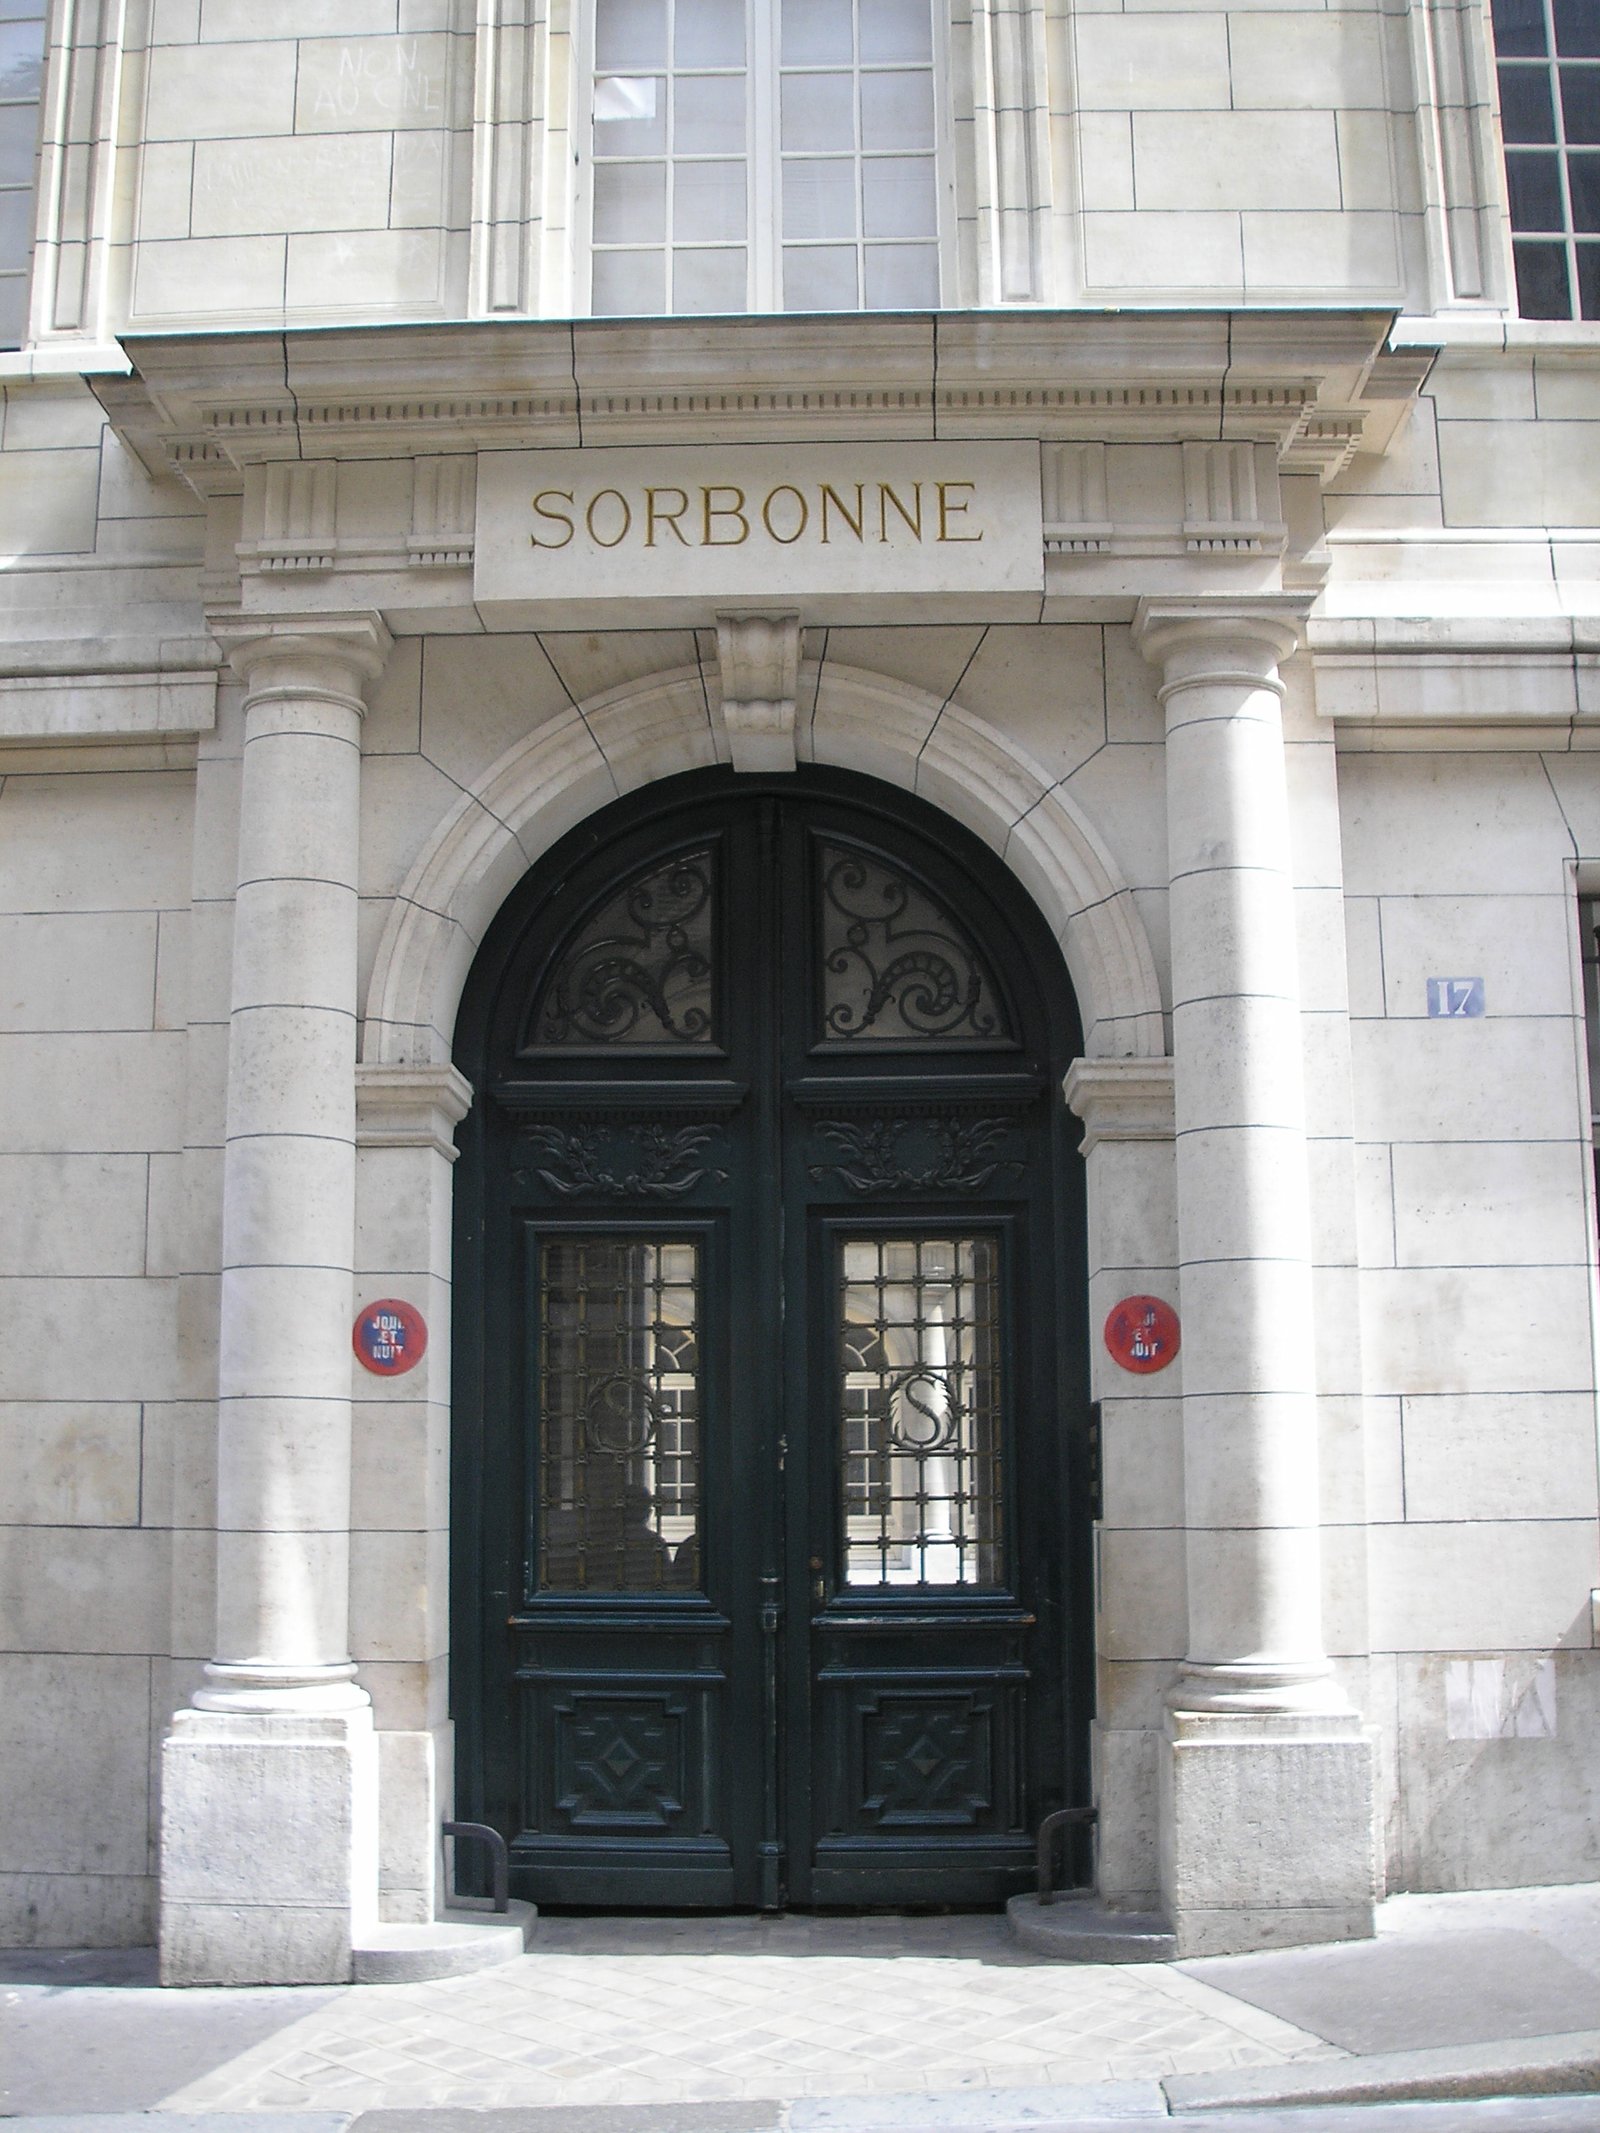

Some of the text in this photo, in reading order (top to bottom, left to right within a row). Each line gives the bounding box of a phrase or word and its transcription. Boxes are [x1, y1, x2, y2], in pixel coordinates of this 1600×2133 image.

[339, 39, 417, 79] NON
[313, 81, 360, 117] AU
[531, 481, 984, 549] SORBONNE
[1437, 981, 1474, 1015] 17
